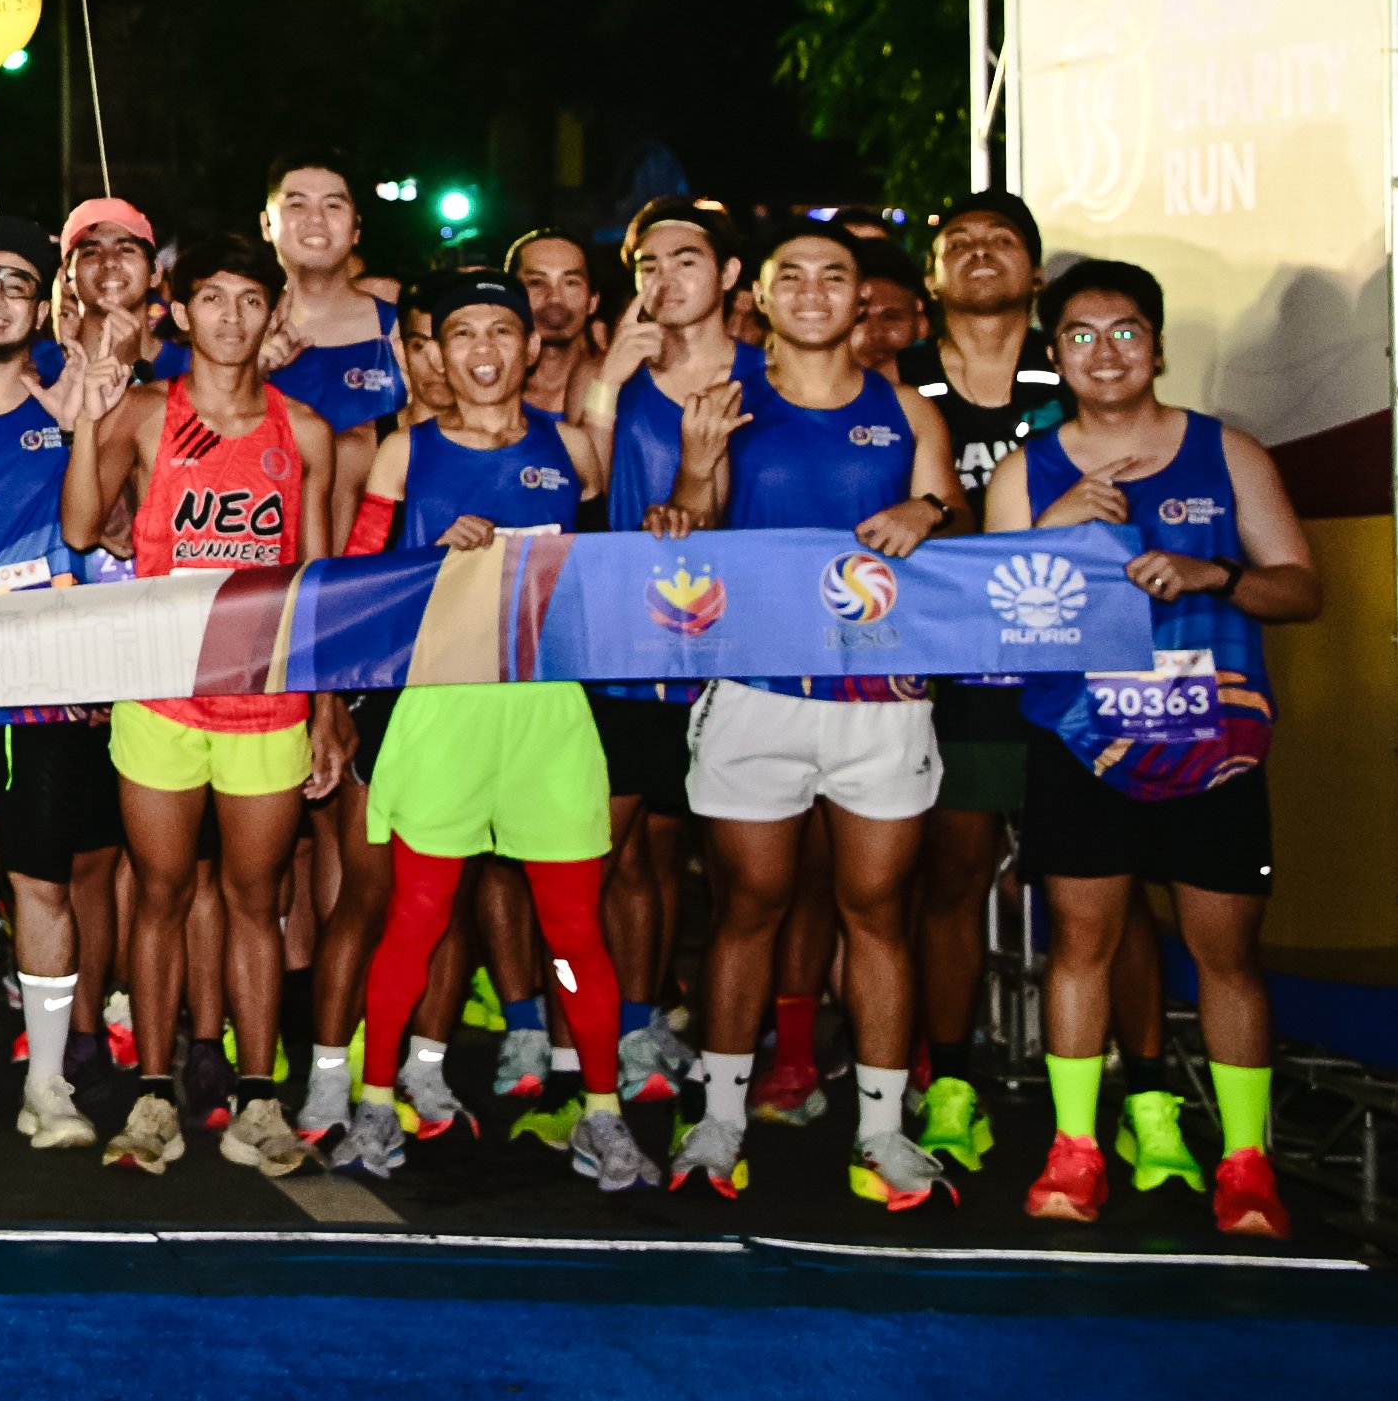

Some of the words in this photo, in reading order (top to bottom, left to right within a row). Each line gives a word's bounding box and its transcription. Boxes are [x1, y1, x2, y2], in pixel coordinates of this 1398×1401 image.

[1160, 37, 1349, 132] CHARITY
[1164, 141, 1256, 217] RUN
[173, 488, 284, 538] NEO
[175, 541, 281, 566] RUNNERS
[1095, 685, 1210, 717] 20363
